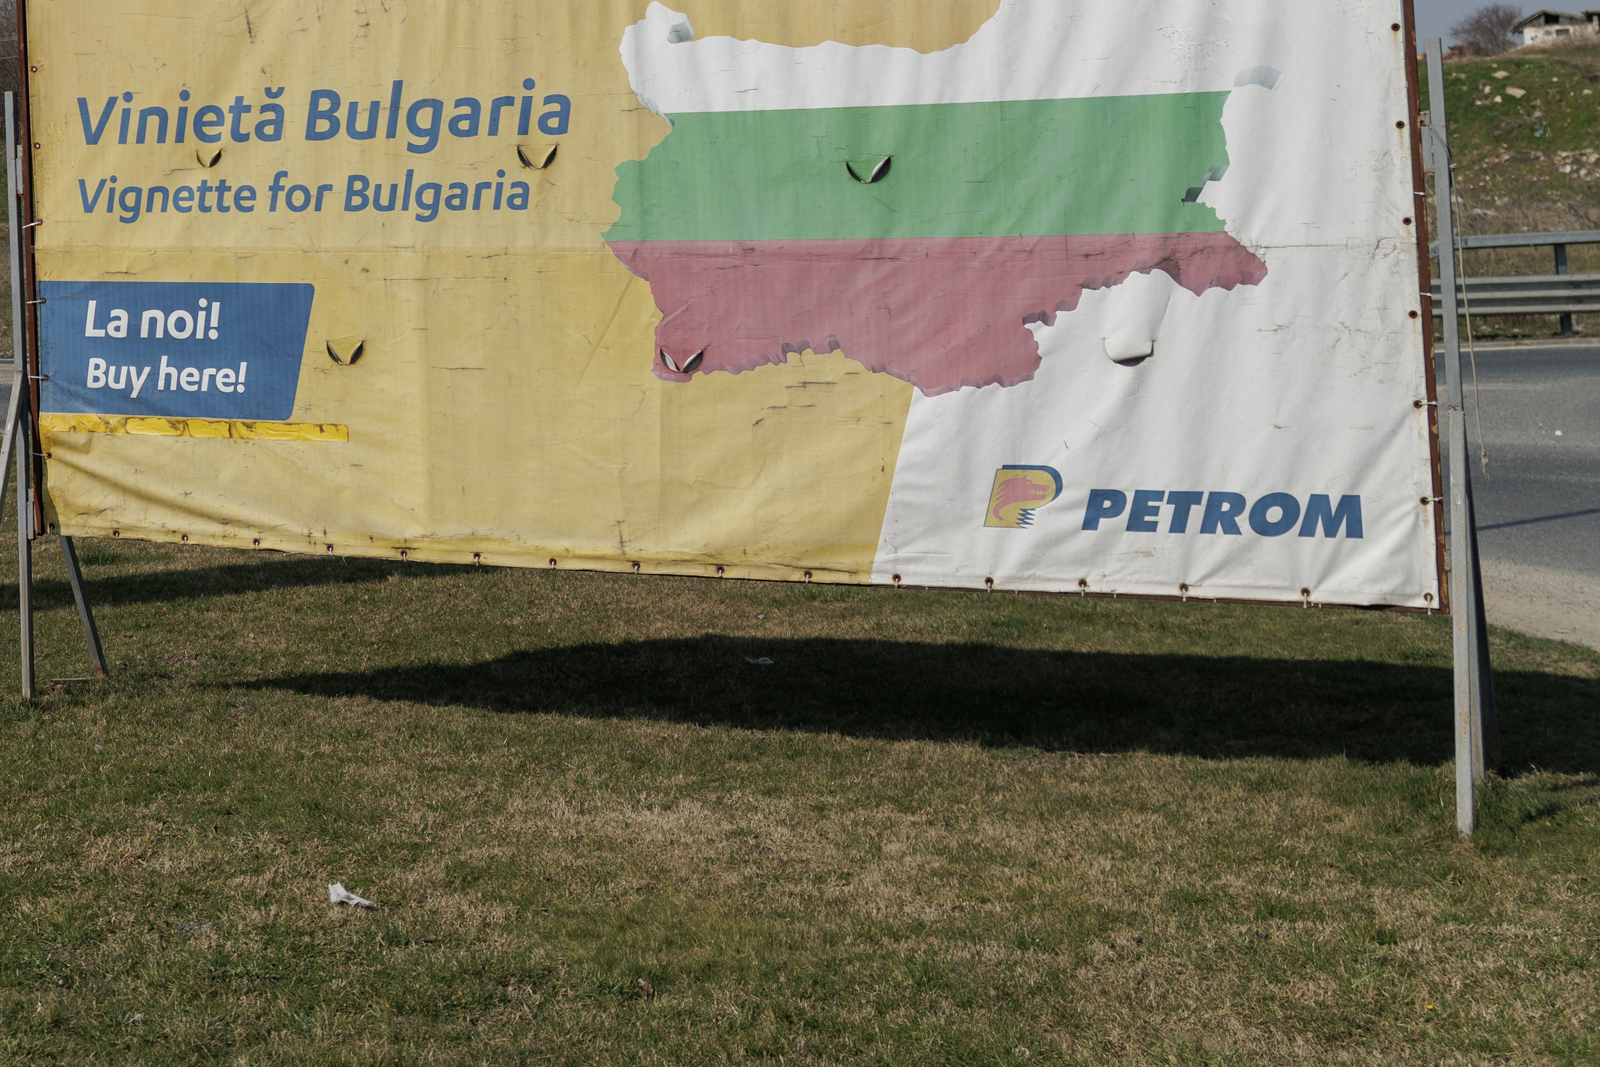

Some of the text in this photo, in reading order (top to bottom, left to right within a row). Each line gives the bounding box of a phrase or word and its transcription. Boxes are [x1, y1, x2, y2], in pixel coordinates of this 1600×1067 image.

[76, 78, 571, 154] Vinietă Bulgaria
[78, 168, 530, 224] Vignette for Bulgaria
[84, 298, 220, 340] La noi!
[86, 355, 247, 399] Buy here!
[1082, 487, 1364, 540] PETROM
